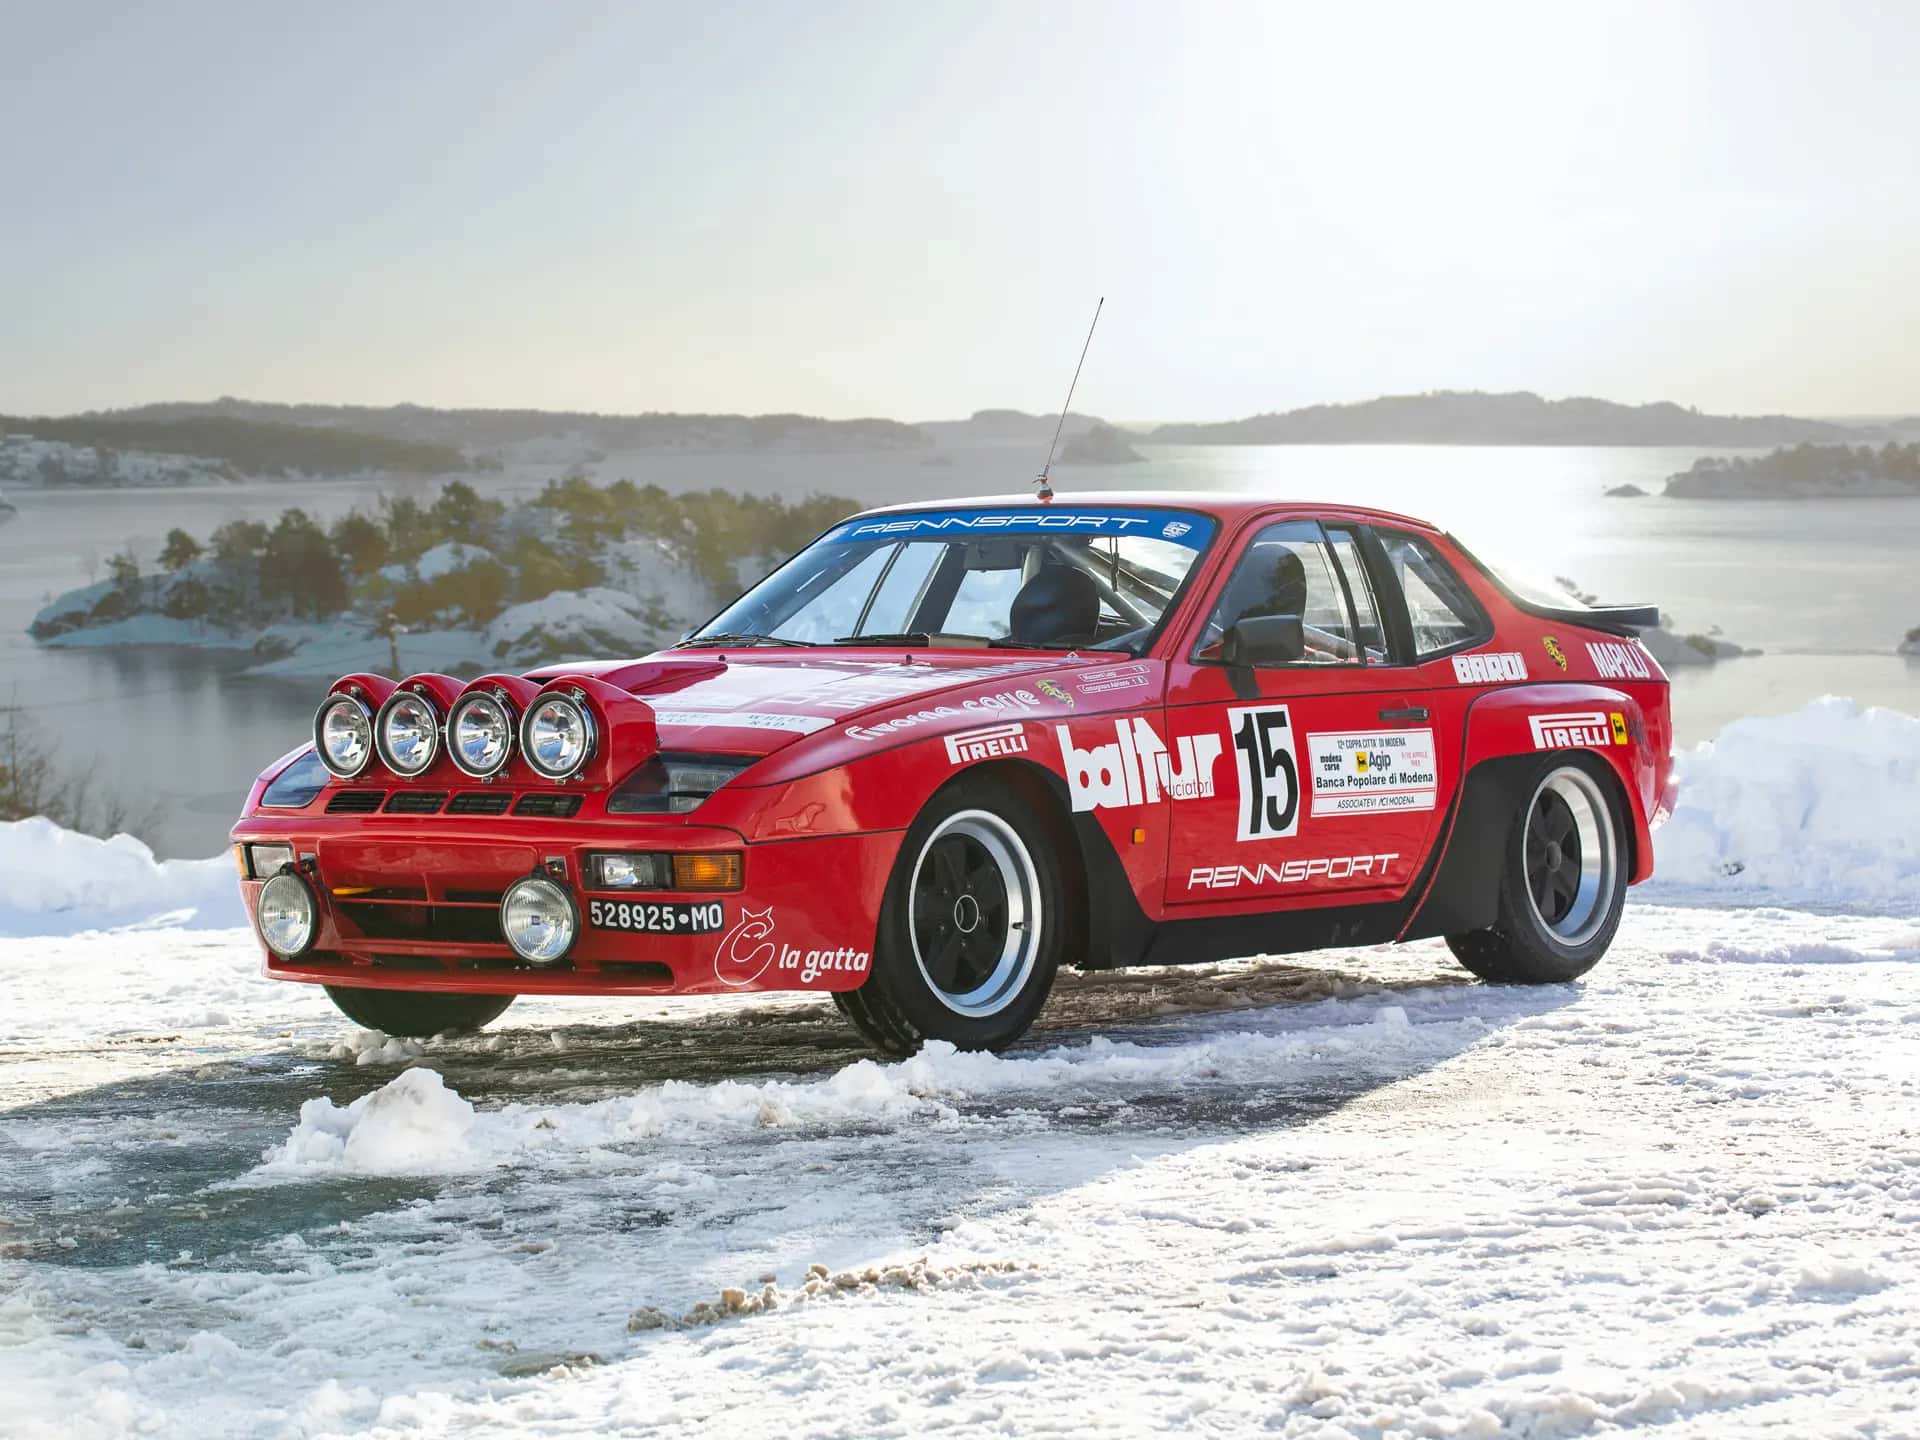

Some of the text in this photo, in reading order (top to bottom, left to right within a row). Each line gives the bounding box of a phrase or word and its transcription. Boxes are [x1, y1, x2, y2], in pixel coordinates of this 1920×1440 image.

[853, 515, 1149, 536] RENNSPORT
[1528, 712, 1611, 749] PIRELLI
[943, 723, 1028, 765] PIRELLI
[1385, 737, 1406, 747] MODENA
[1056, 717, 1223, 813] baltur
[1320, 754, 1342, 763] modena
[1324, 763, 1340, 771] corse
[1369, 751, 1391, 771] Agip
[1234, 711, 1300, 834] 15
[1316, 772, 1433, 789] Banca Popolare di Modena
[1337, 798, 1376, 808] ASSOCIATEVI
[1389, 796, 1415, 805] MODENA
[1187, 853, 1399, 890] RENNSPORT
[779, 944, 869, 983] la gatta
